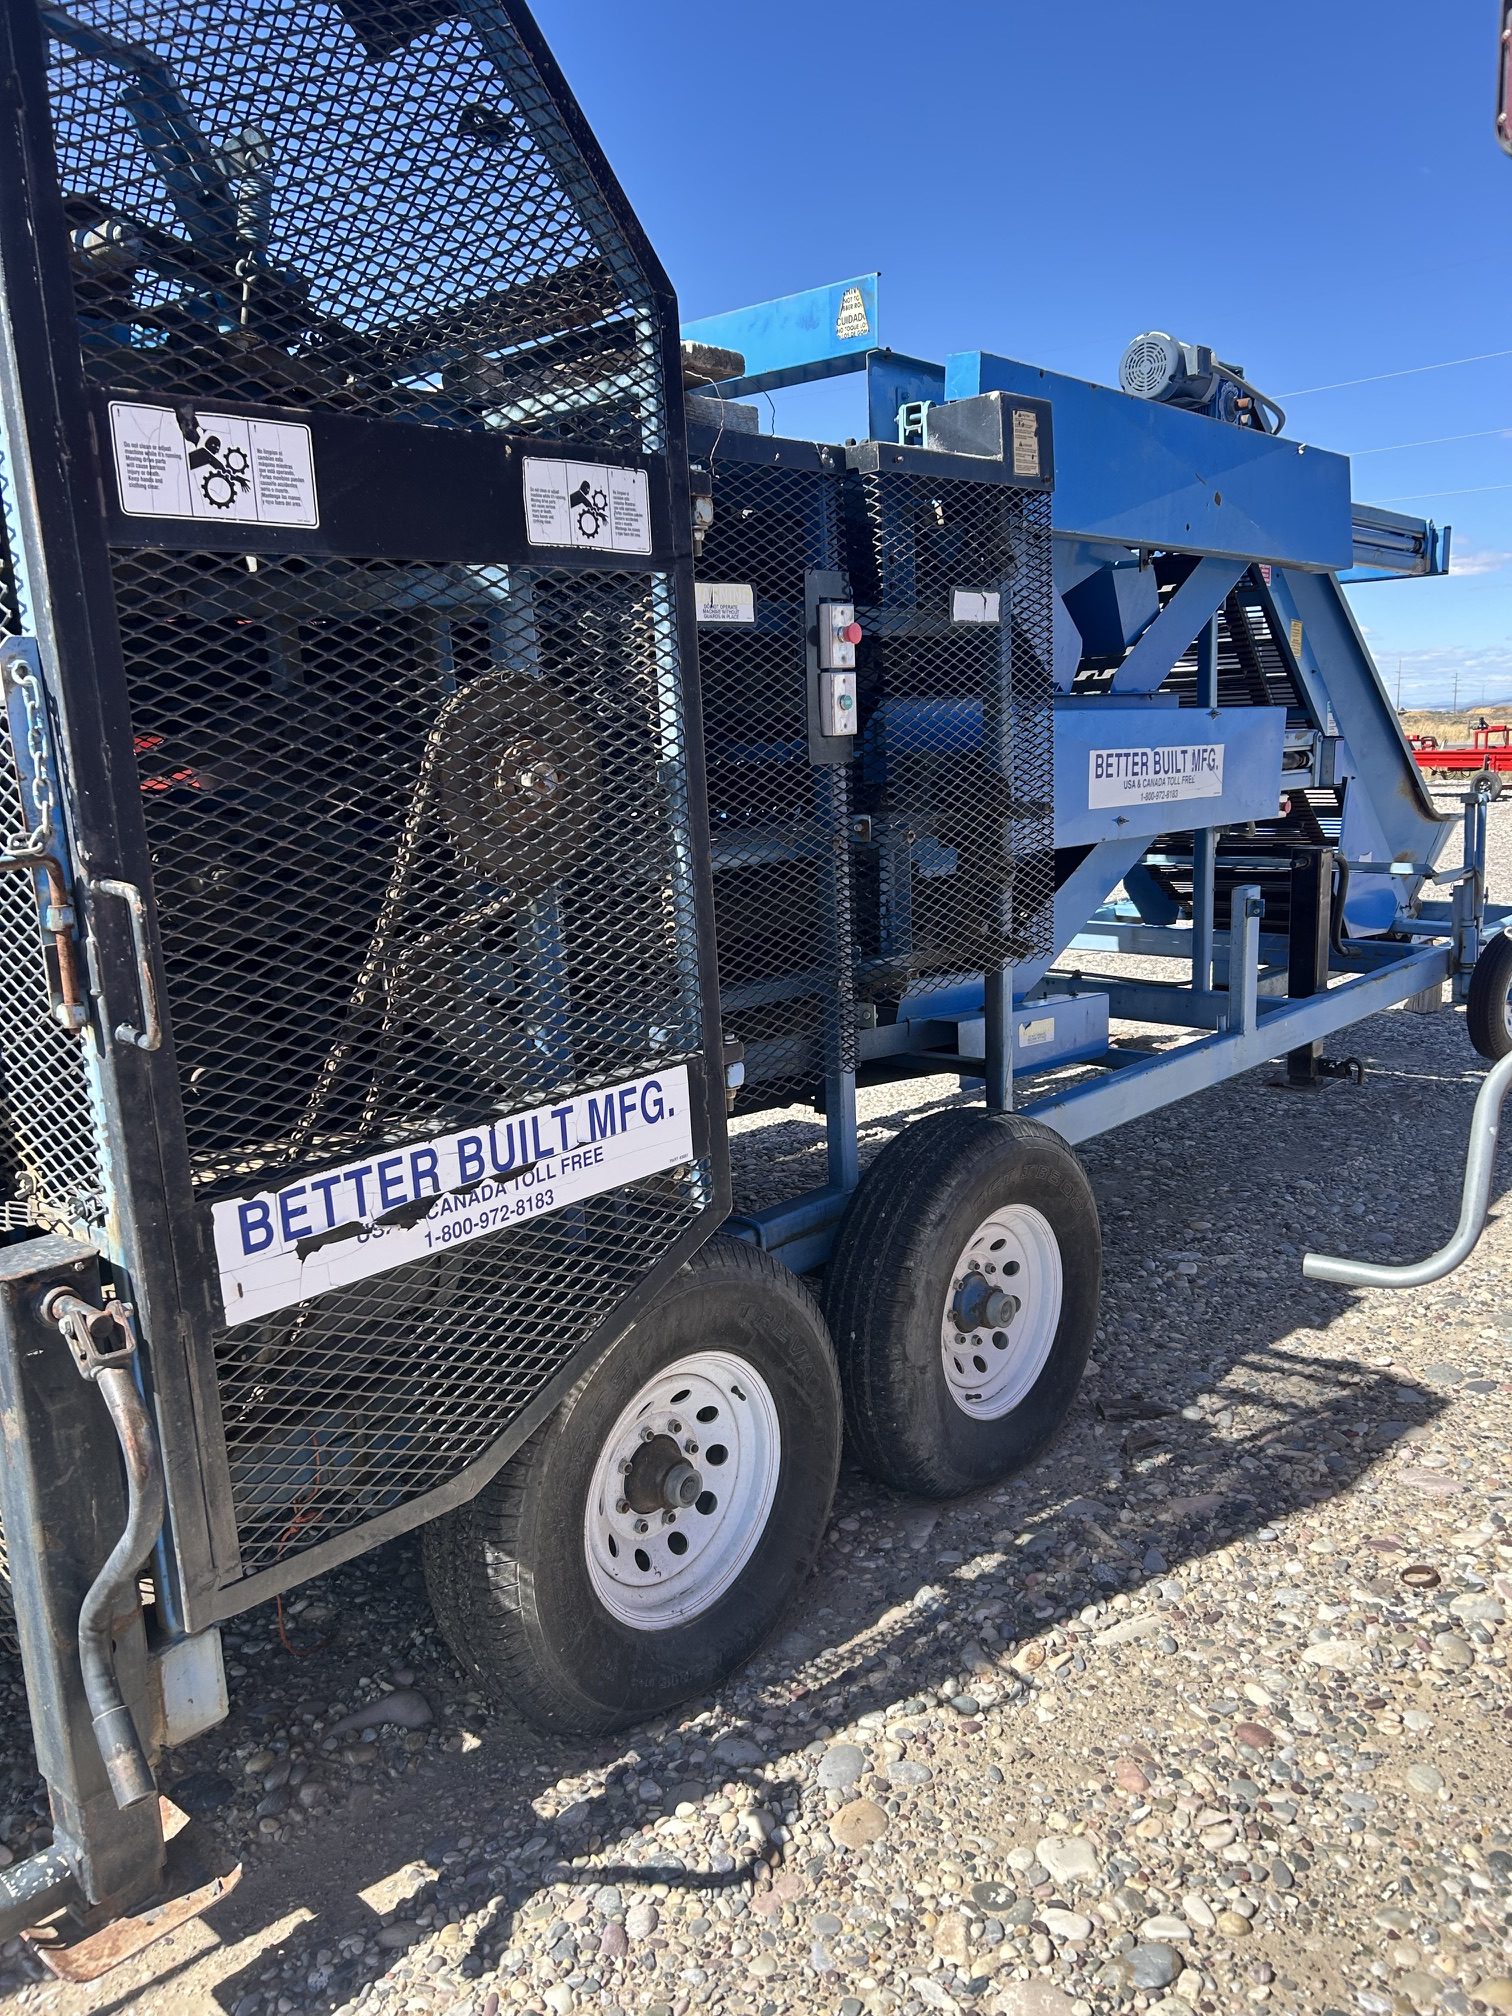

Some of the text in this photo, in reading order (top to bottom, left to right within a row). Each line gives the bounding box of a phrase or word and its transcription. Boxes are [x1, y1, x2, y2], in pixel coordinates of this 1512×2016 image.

[1095, 748, 1218, 779] BETTER BUILT MFG.
[1124, 780, 1135, 789] USA
[1137, 780, 1141, 788] &
[1142, 777, 1166, 788] CANADA
[1167, 776, 1180, 785] TOLL
[238, 1080, 674, 1256] BETTER BUILT MFG.
[427, 1182, 508, 1220] CANADA
[561, 1146, 604, 1174] FREE
[424, 1190, 554, 1248] 1-800-972-8183
